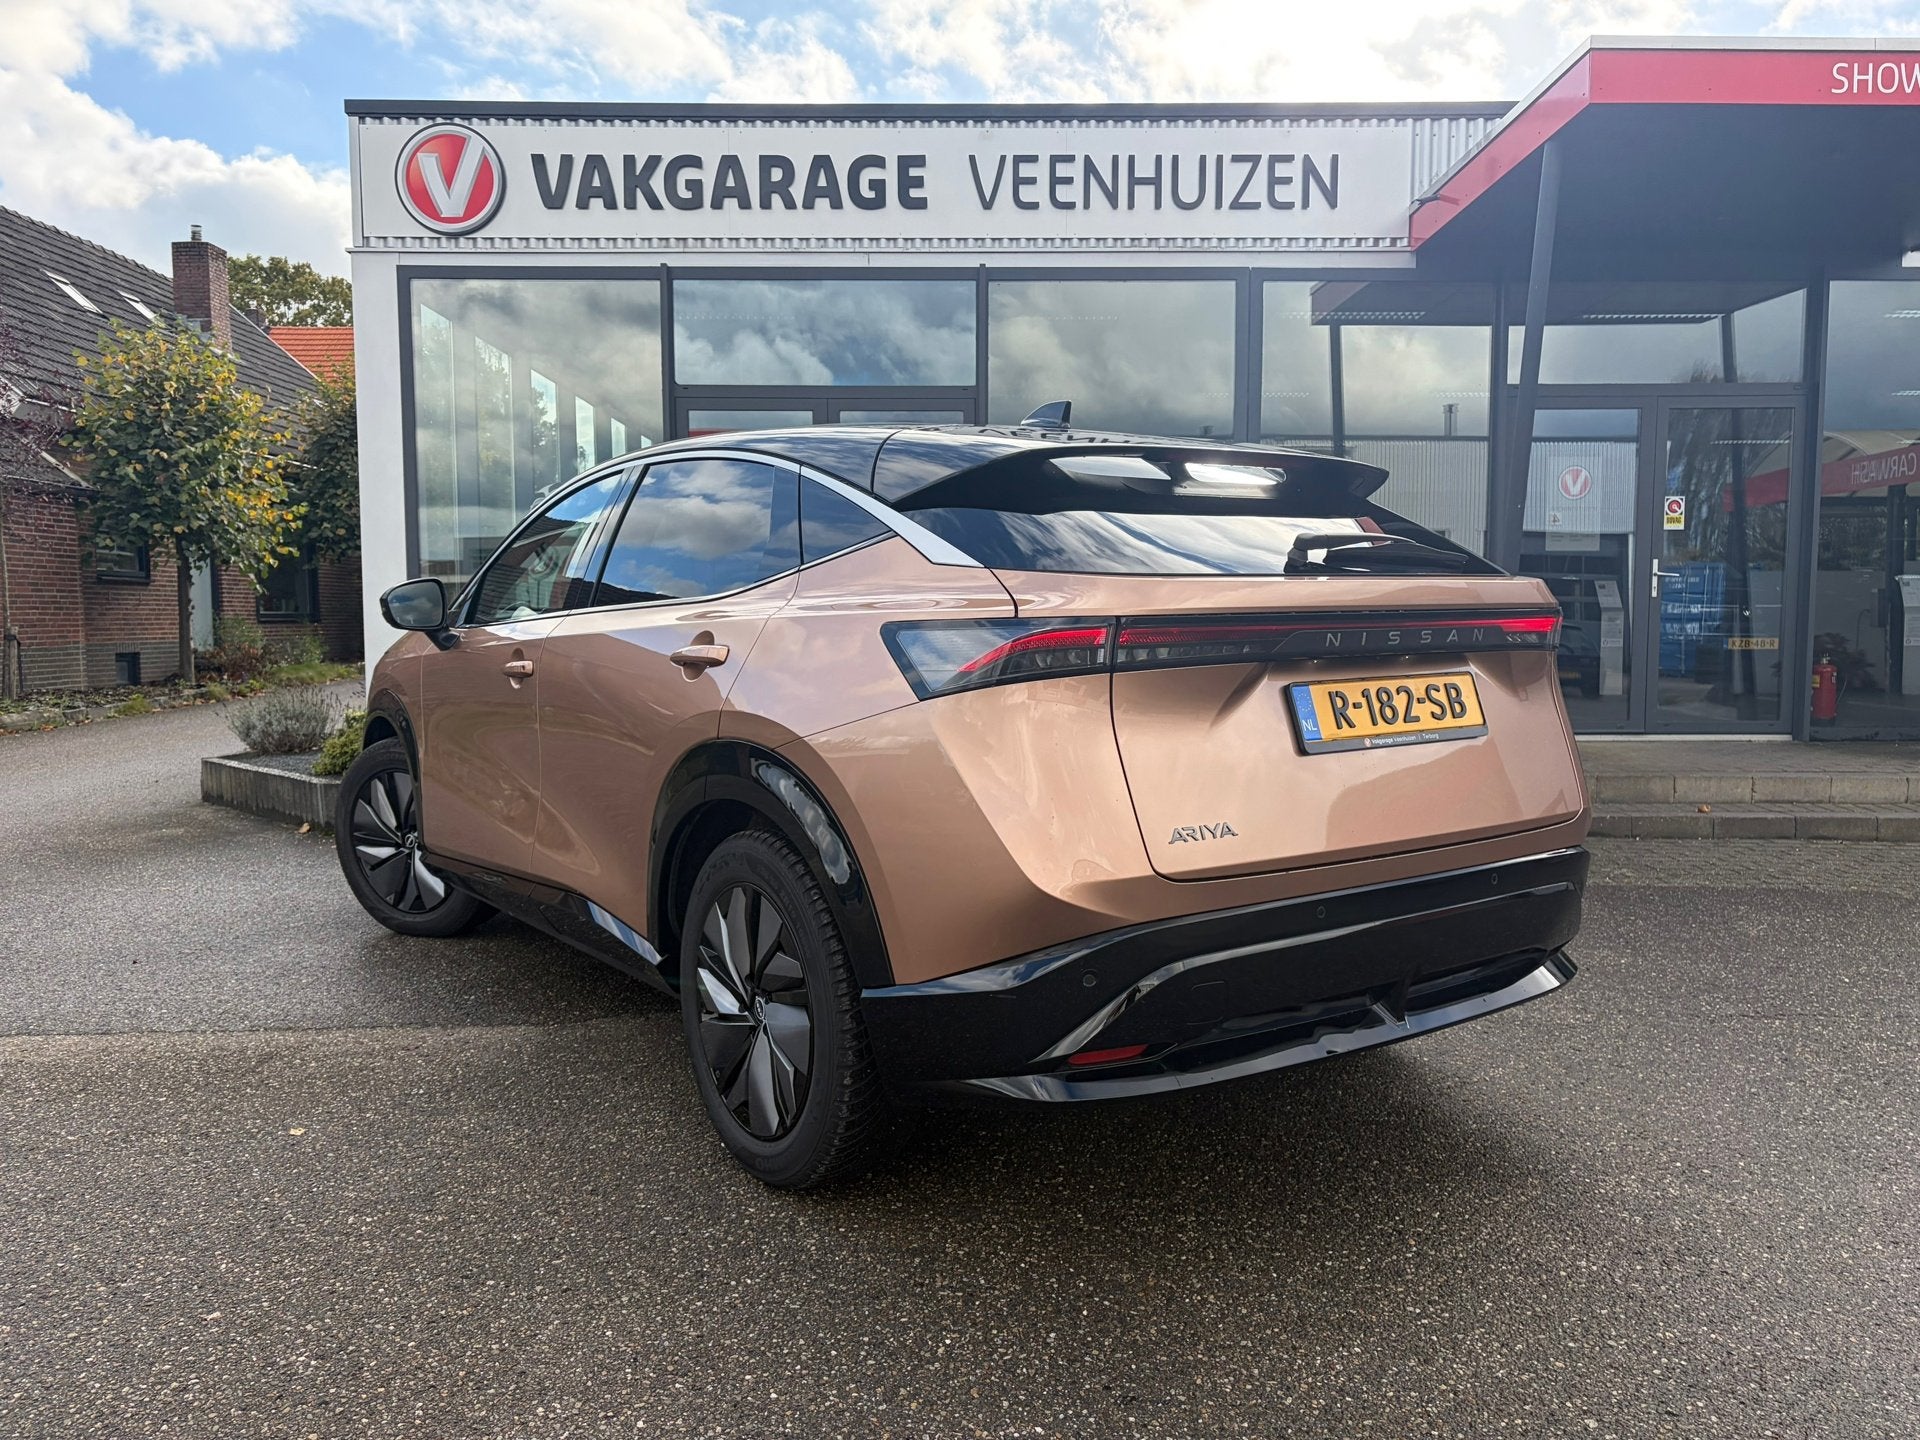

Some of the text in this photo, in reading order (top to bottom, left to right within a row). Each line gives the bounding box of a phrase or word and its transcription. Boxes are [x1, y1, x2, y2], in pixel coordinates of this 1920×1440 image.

[530, 153, 1340, 211] VAKGARAGE VEENHUIZEN
[1325, 628, 1484, 647] NISSAN
[1328, 682, 1467, 730] R-182-SB
[1302, 719, 1317, 731] NL
[1168, 821, 1239, 844] ARIYA
